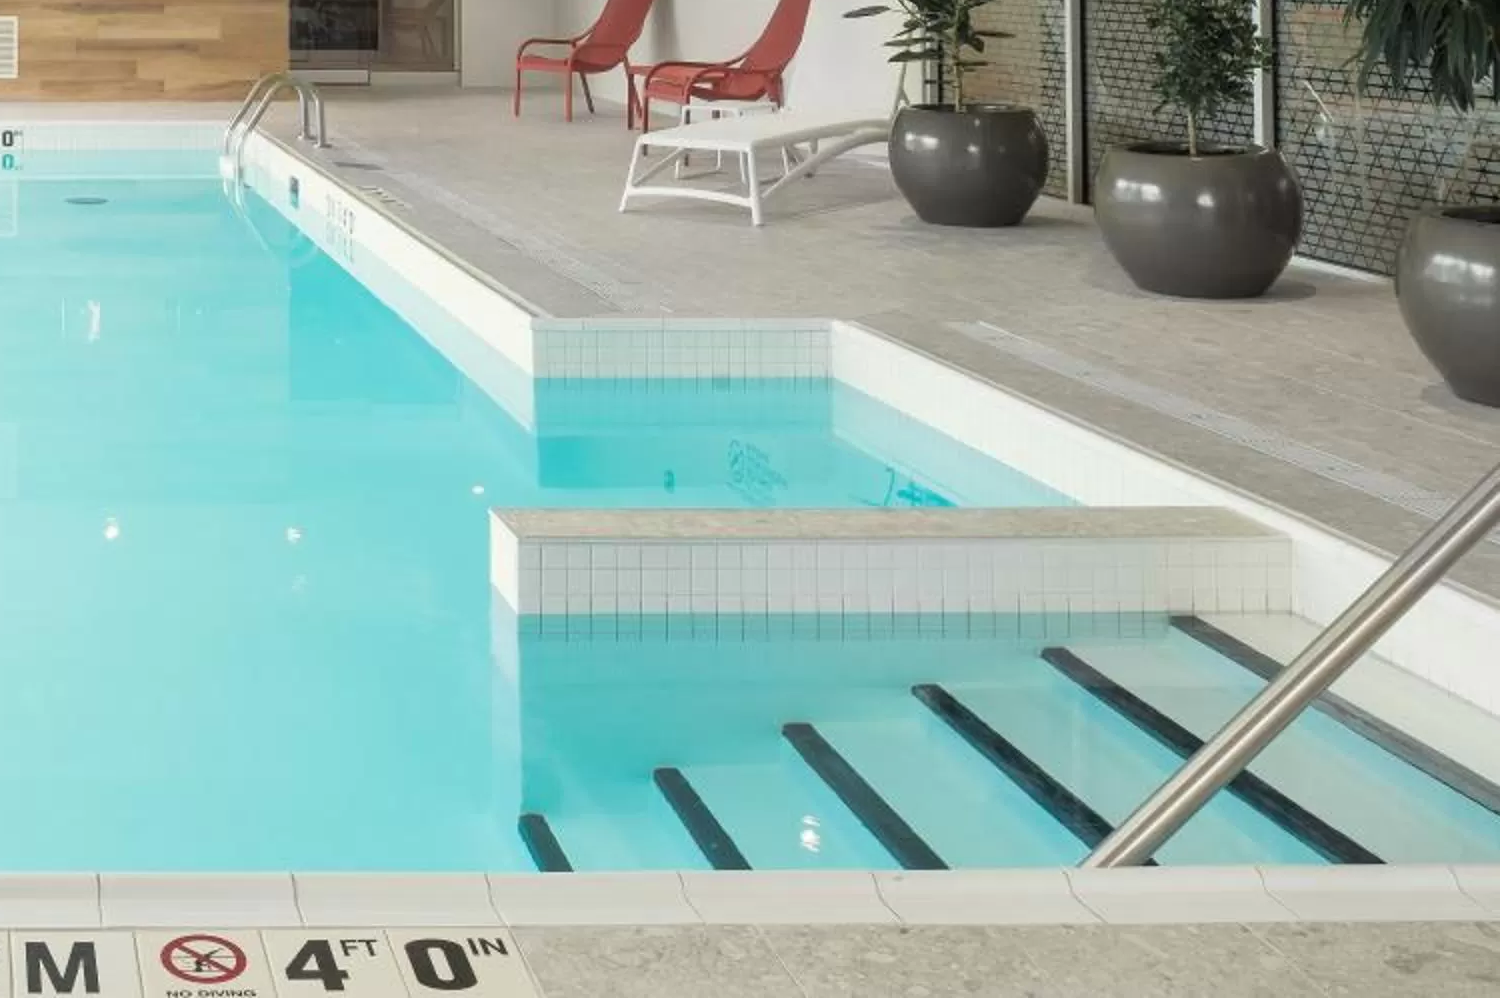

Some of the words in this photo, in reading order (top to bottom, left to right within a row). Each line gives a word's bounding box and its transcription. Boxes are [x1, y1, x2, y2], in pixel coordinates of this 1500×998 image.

[25, 941, 100, 994] M
[166, 990, 193, 998] NO
[197, 989, 257, 998] DIVING
